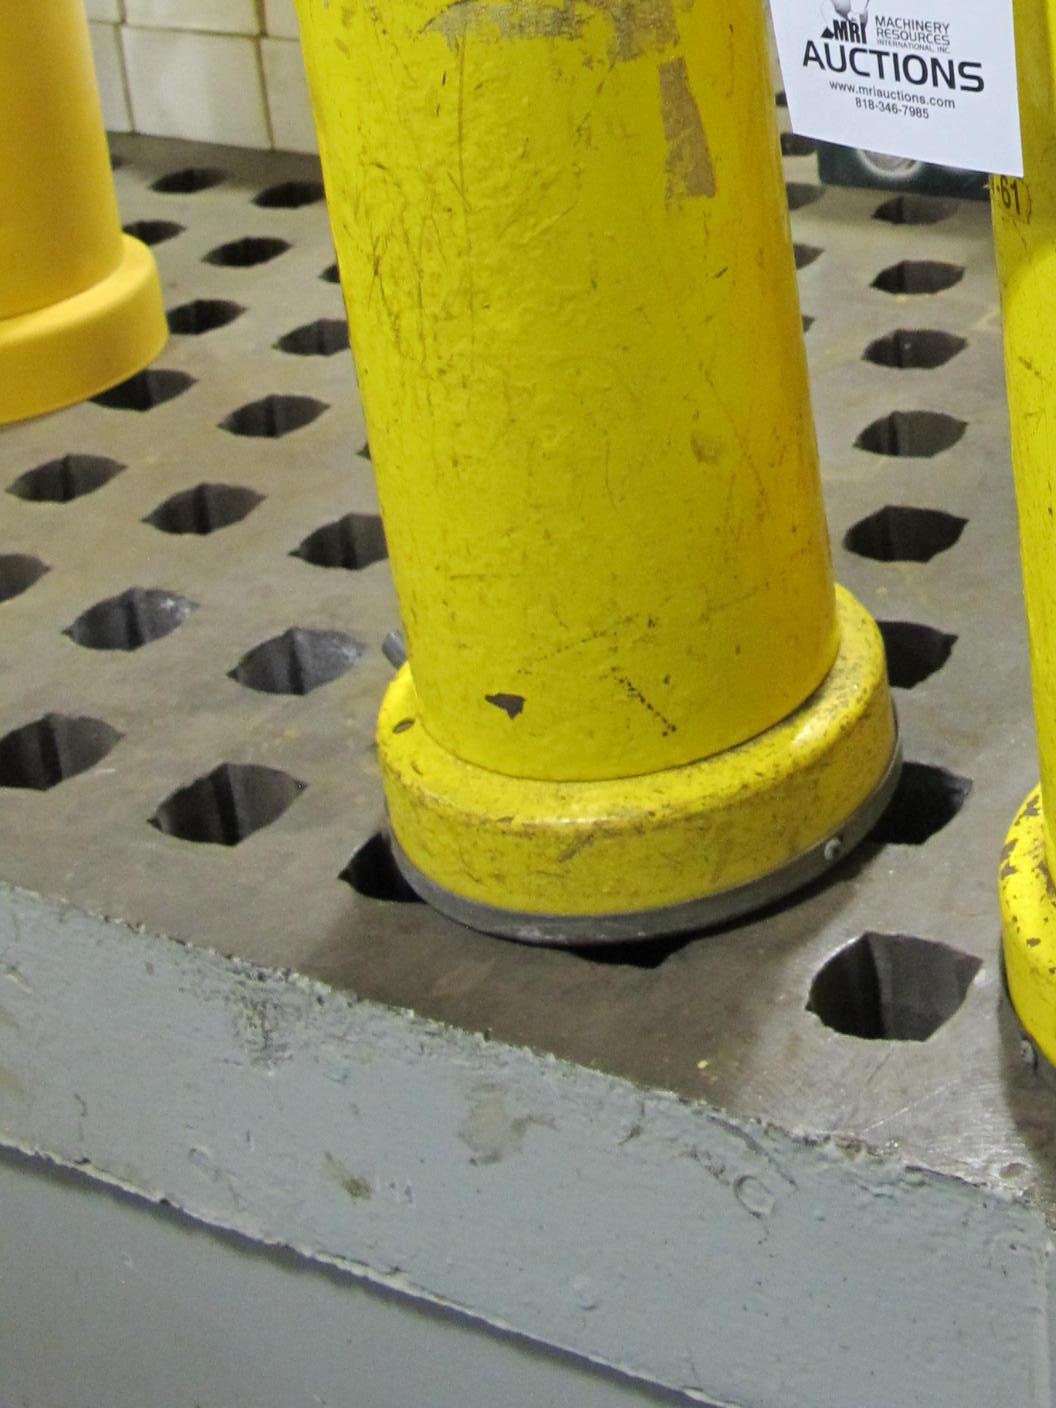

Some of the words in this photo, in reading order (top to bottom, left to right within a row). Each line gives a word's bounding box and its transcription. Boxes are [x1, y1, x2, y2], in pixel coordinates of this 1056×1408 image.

[833, 19, 867, 44] MRI
[875, 15, 950, 33] MACHINERY
[876, 27, 950, 46] RESOURCES
[803, 40, 985, 93] AUCTIONS
[829, 80, 955, 109] www.mriauctions.com
[855, 97, 930, 119] 818-346-7985
